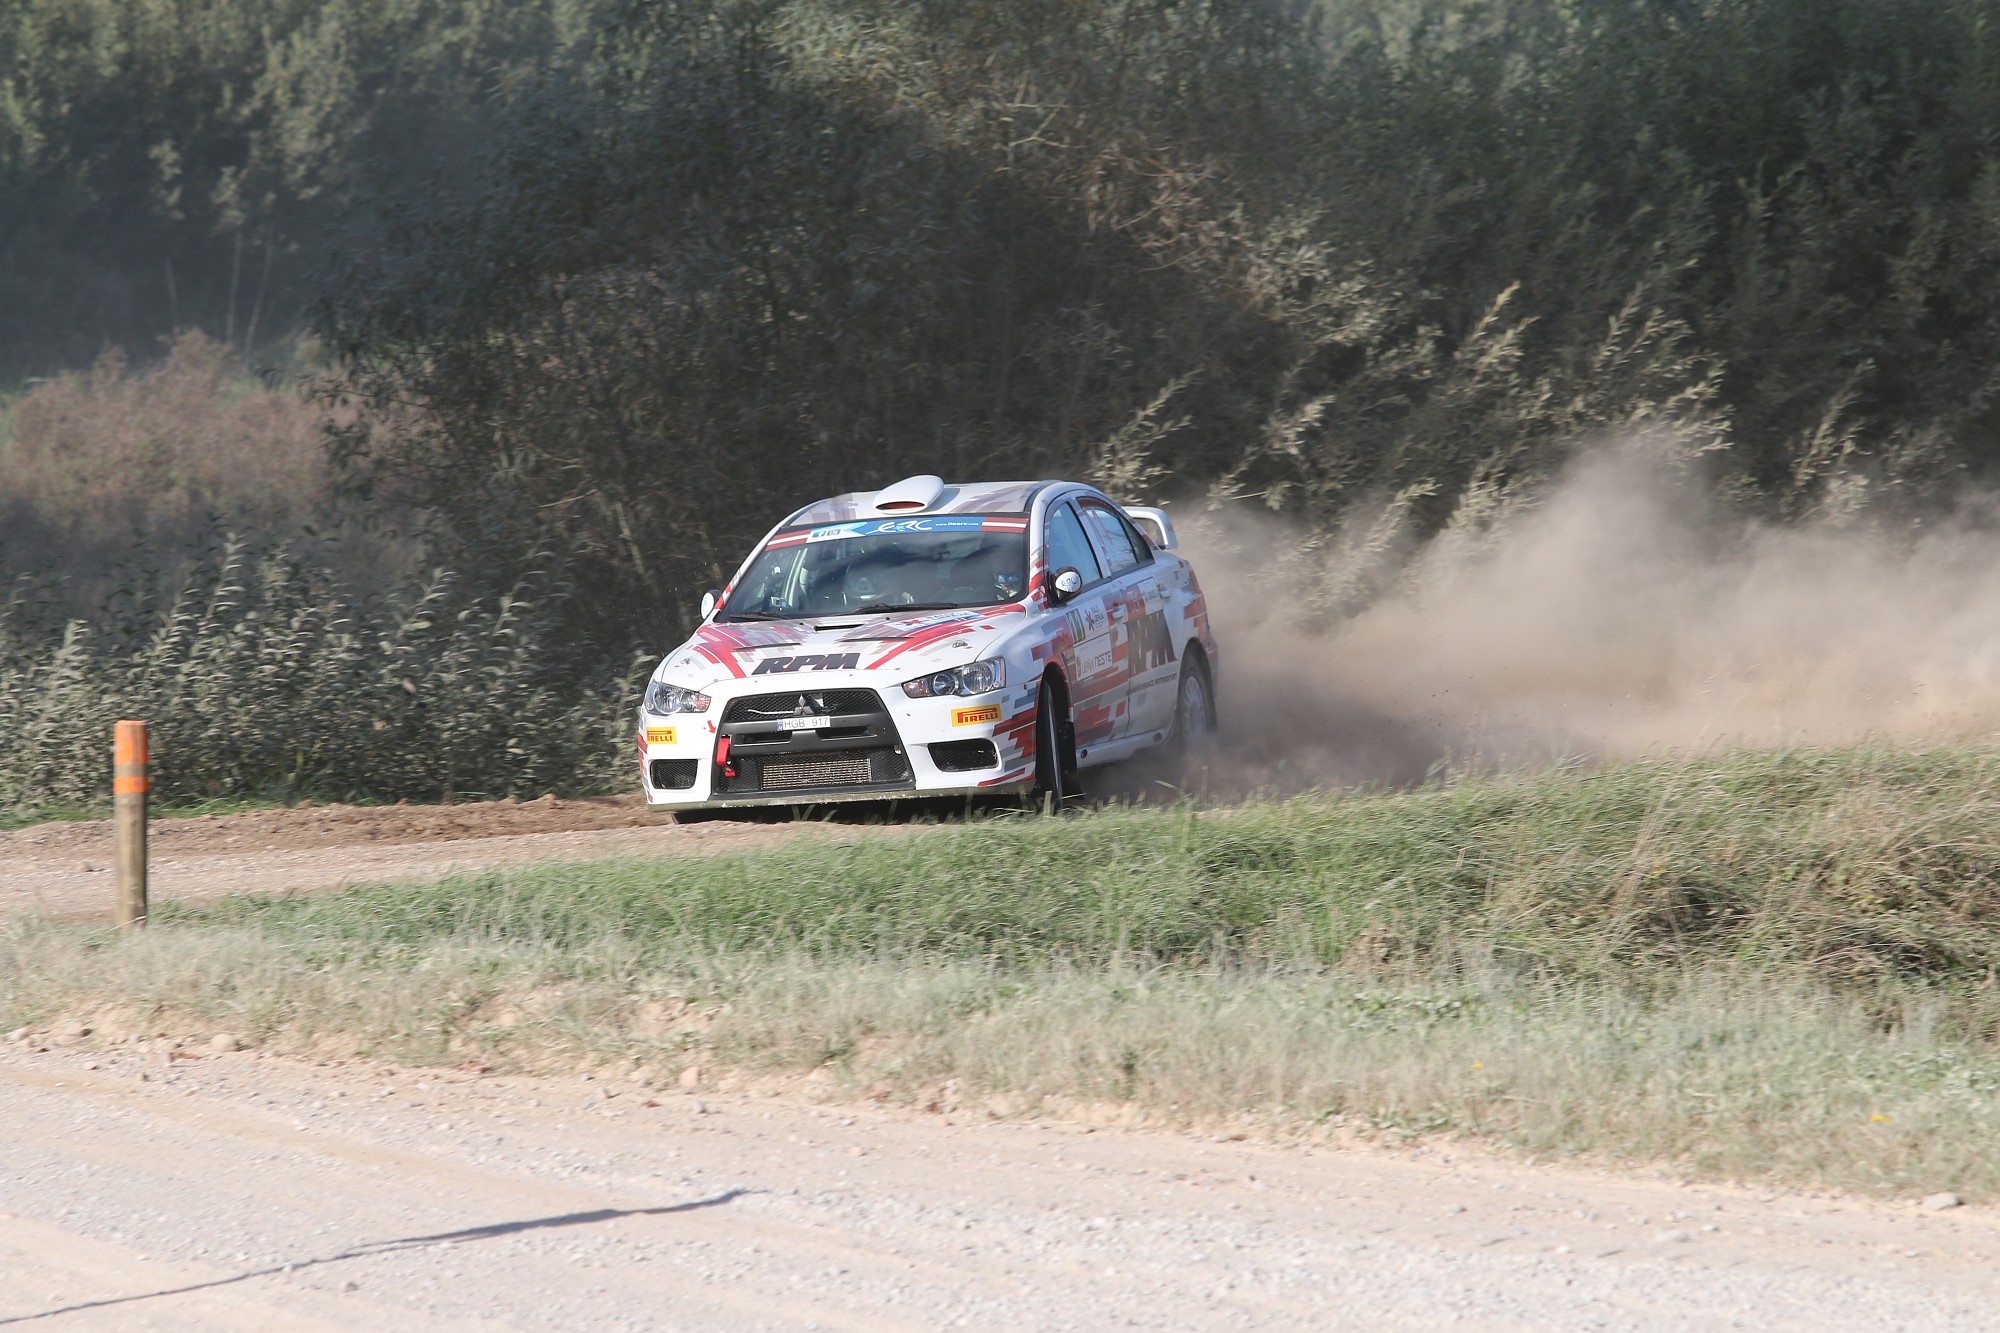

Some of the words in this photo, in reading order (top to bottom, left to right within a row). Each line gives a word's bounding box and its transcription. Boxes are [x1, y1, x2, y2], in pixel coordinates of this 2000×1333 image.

[1126, 613, 1178, 678] RPM
[752, 653, 860, 675] RPM
[1094, 651, 1111, 668] NESTE
[957, 708, 999, 723] PIRELLI
[785, 720, 804, 730] HGB
[811, 718, 829, 728] 917
[646, 730, 673, 742] PIRELLI
